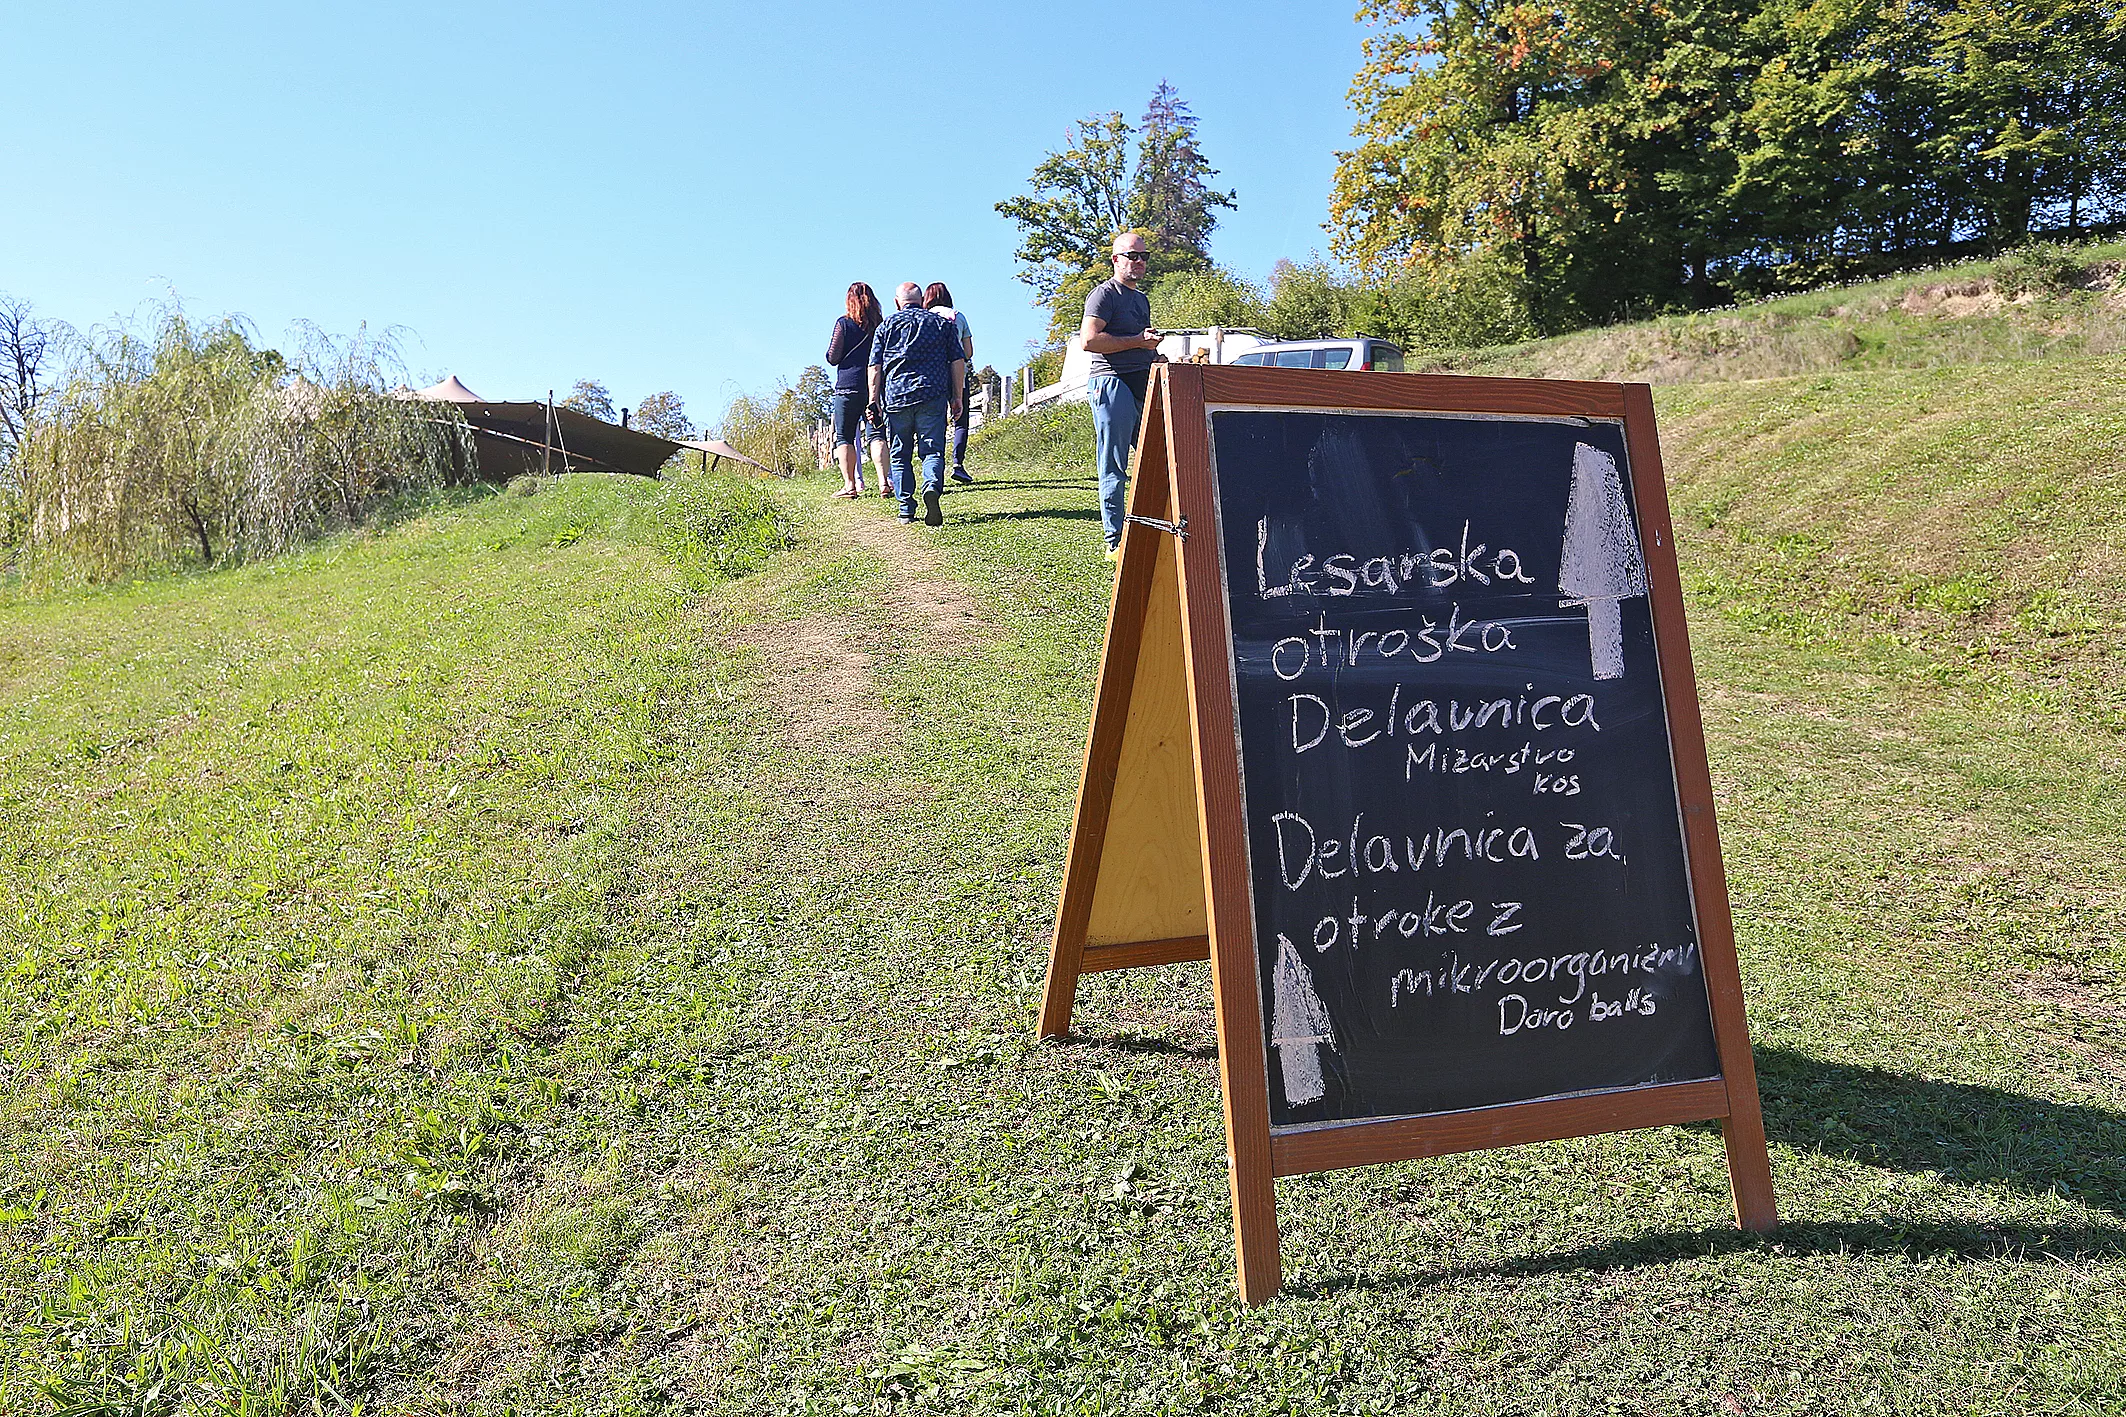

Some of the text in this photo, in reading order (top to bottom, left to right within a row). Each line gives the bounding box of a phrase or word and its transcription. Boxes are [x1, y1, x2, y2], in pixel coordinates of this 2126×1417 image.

[1255, 514, 1536, 599] Lesarska
[1271, 601, 1517, 681] otroška
[1405, 741, 1576, 783] Mizarstvo
[1271, 811, 1540, 891] Delavnica
[1313, 890, 1473, 954] otroke
